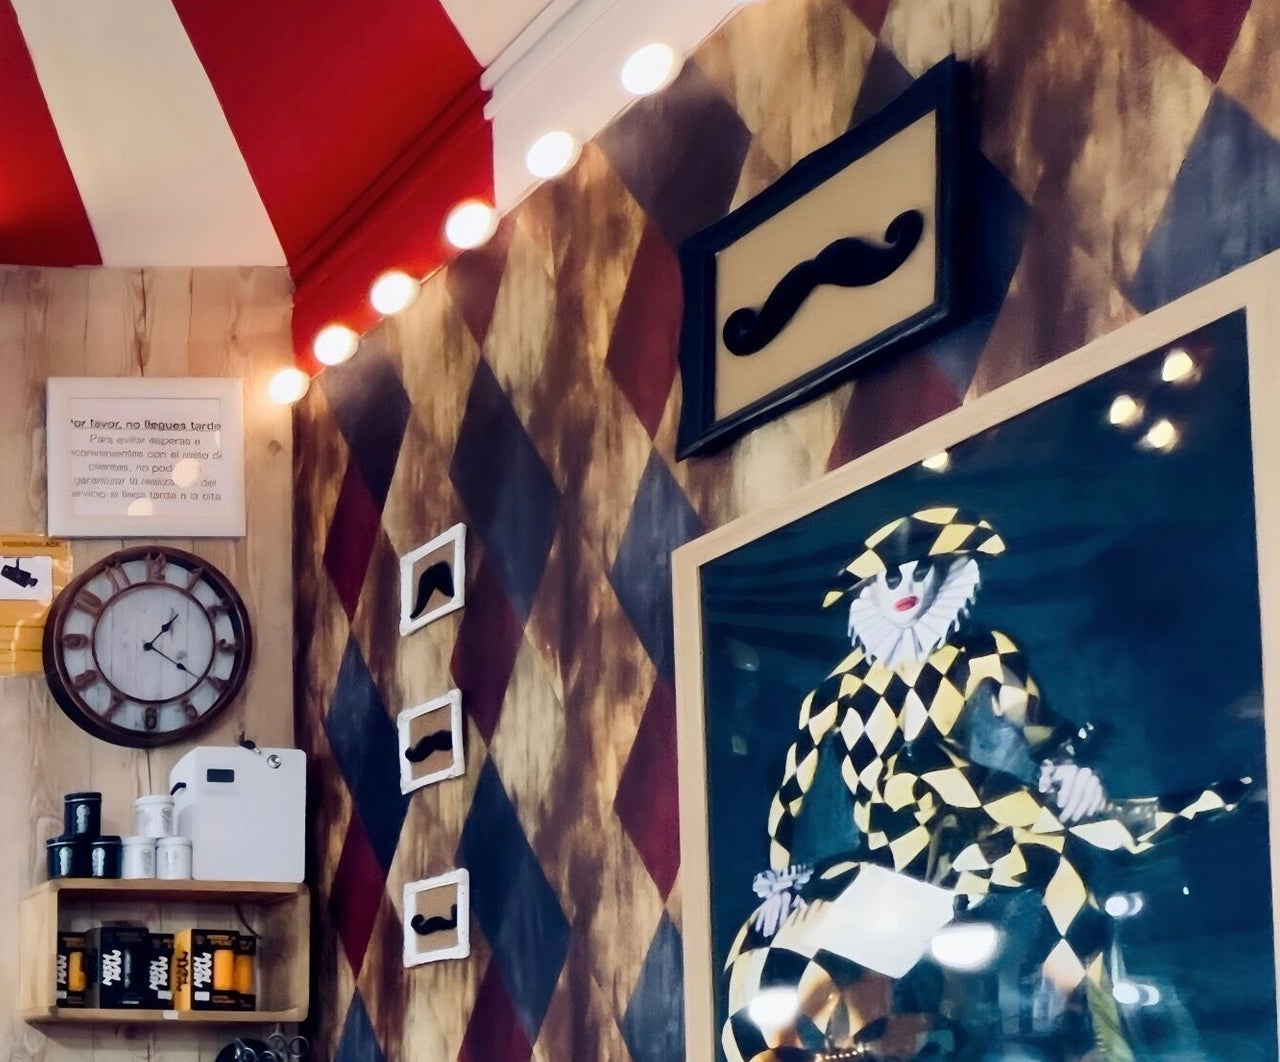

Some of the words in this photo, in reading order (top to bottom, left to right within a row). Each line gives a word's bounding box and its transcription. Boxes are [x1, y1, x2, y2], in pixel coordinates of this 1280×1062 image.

[90, 418, 123, 430] favor,
[126, 421, 141, 429] no
[144, 419, 187, 432] llegues
